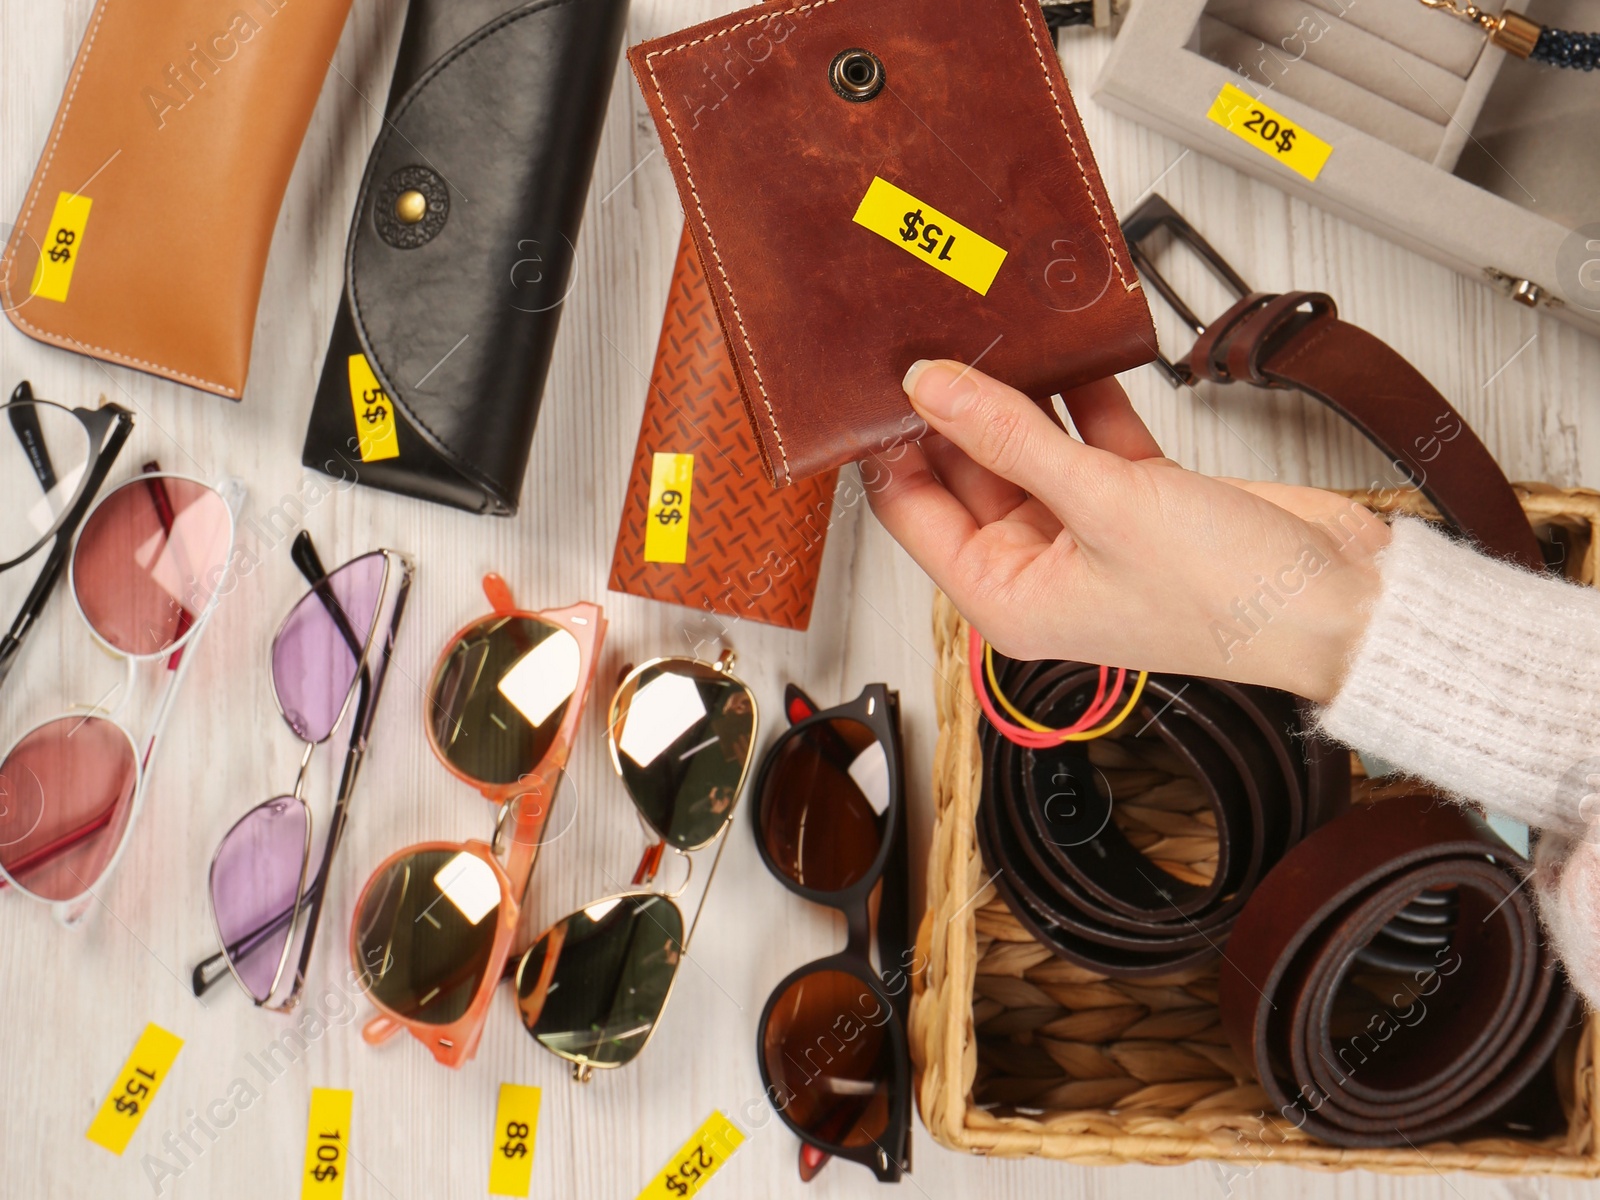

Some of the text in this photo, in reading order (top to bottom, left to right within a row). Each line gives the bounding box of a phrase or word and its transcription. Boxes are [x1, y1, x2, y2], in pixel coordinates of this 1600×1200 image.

[1243, 110, 1297, 154] 20$
[47, 228, 76, 263] 8$
[898, 208, 956, 262] 15$
[362, 387, 388, 425] 5$
[655, 490, 683, 526] 6$
[113, 1067, 155, 1117] 15$
[310, 1131, 341, 1182] 10$
[500, 1121, 529, 1160] 8$
[664, 1144, 714, 1197] 25$
